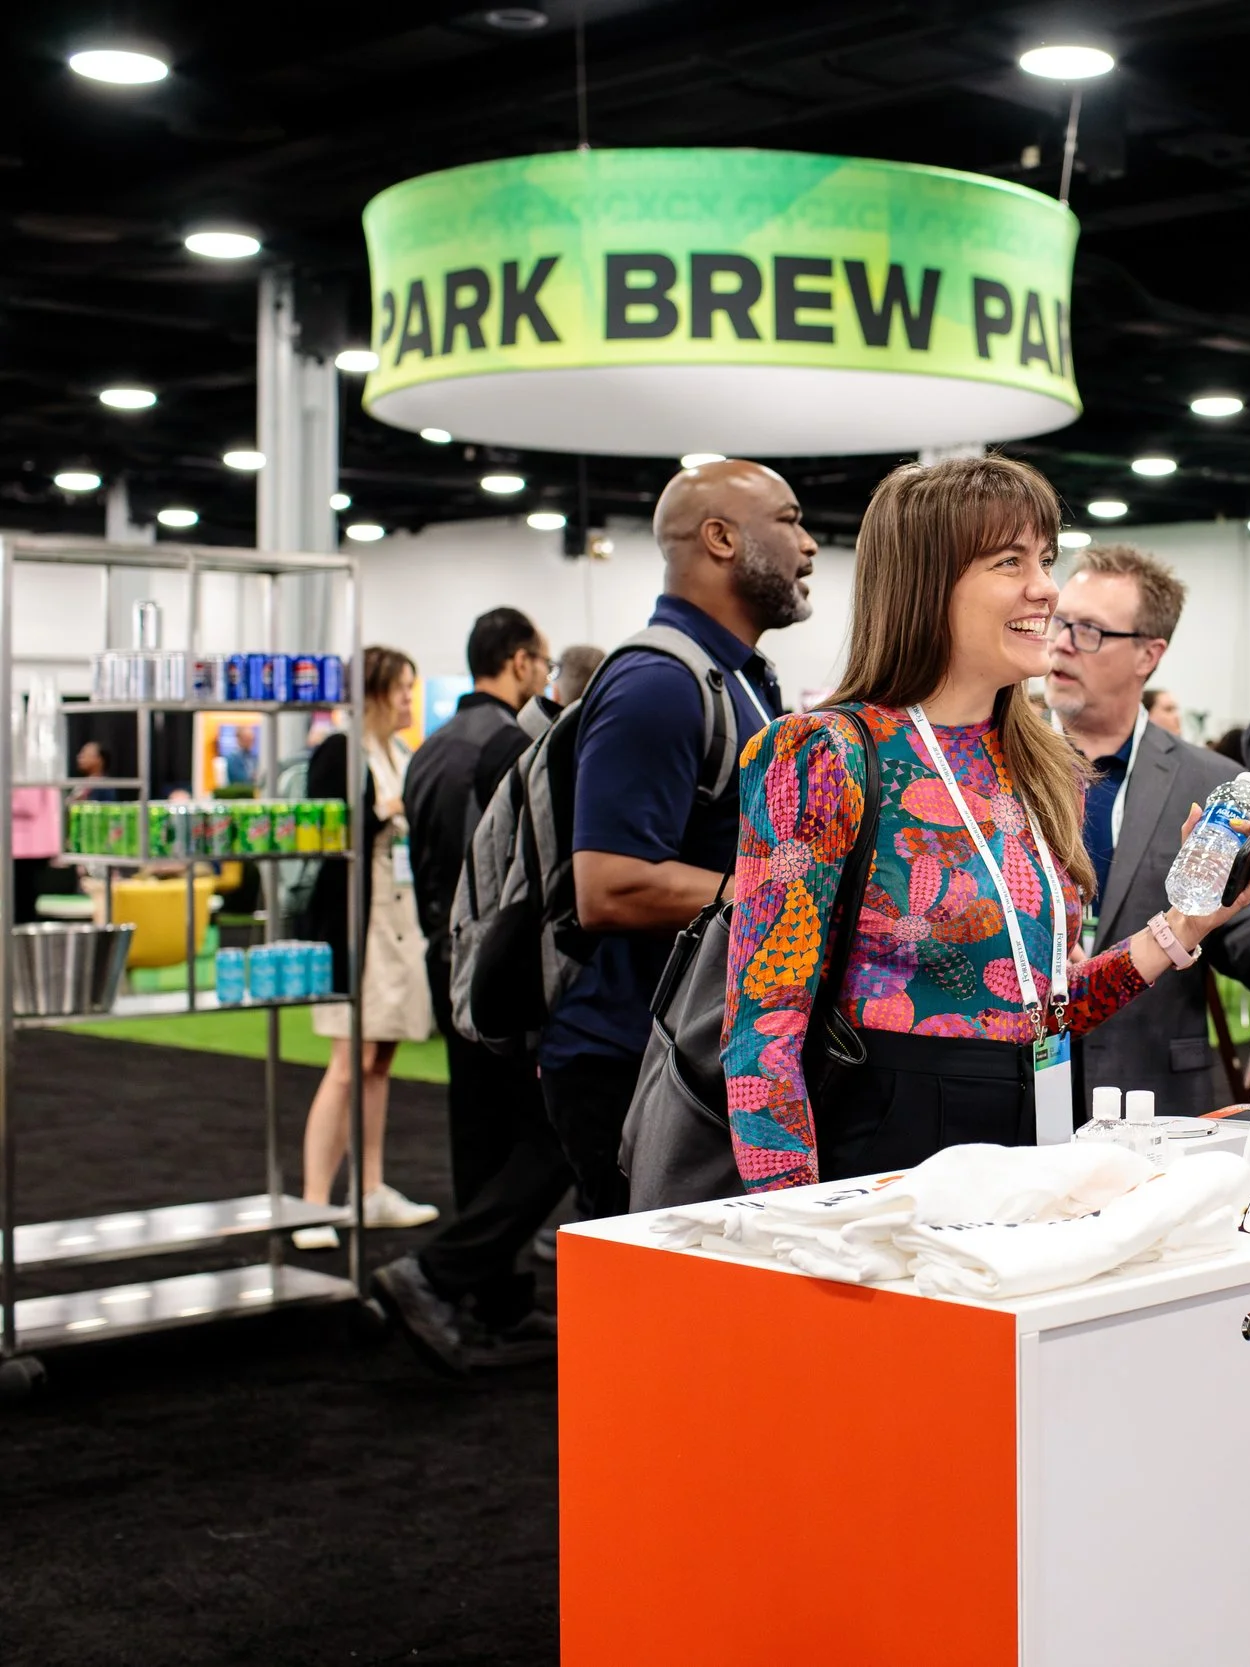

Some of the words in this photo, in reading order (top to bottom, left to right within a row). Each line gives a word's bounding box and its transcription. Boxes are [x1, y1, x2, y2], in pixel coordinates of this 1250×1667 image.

[605, 253, 942, 351] BREW
[1015, 940, 1029, 983] FORRESTER
[1056, 932, 1064, 976] FORRESTER
